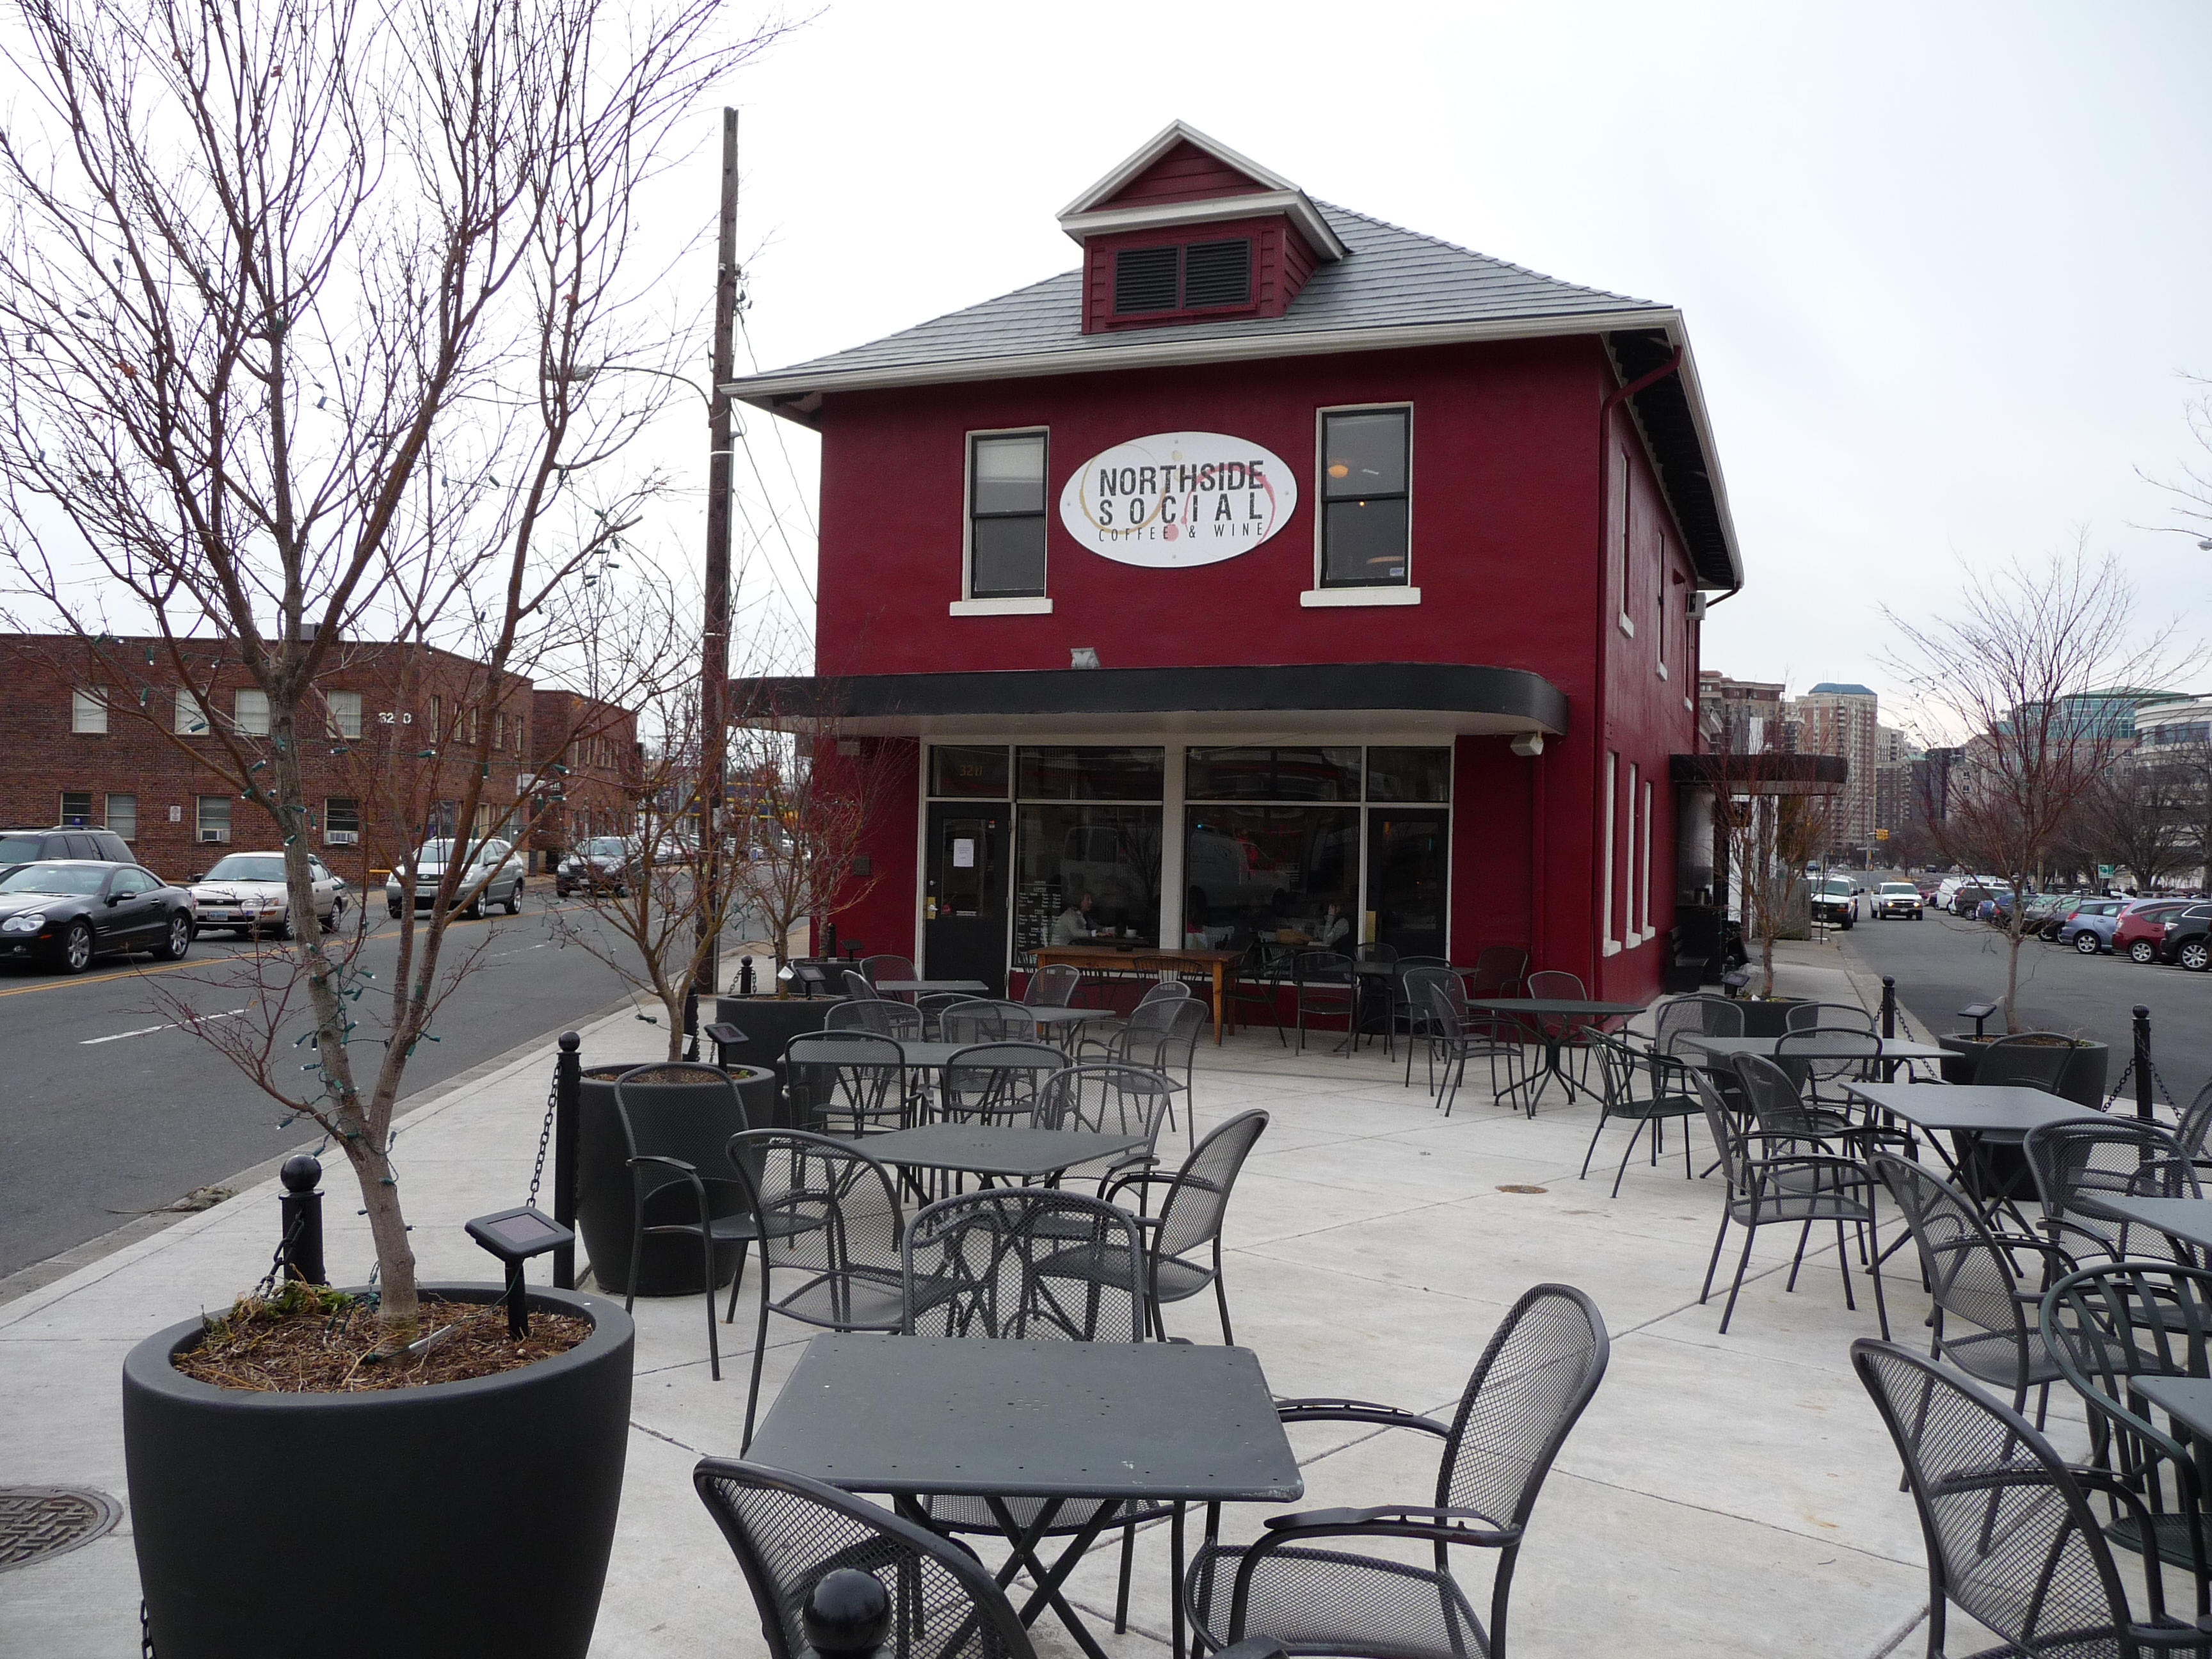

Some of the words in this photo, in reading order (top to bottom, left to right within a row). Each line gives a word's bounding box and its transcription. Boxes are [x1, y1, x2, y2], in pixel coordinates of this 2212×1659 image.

[1100, 460, 1263, 497] NORTHSIDE
[1099, 492, 1262, 525] SOCIAL
[1099, 526, 1168, 541] COFFEE
[1189, 525, 1196, 538] &
[1214, 522, 1263, 537] WINE
[378, 712, 412, 724] 320
